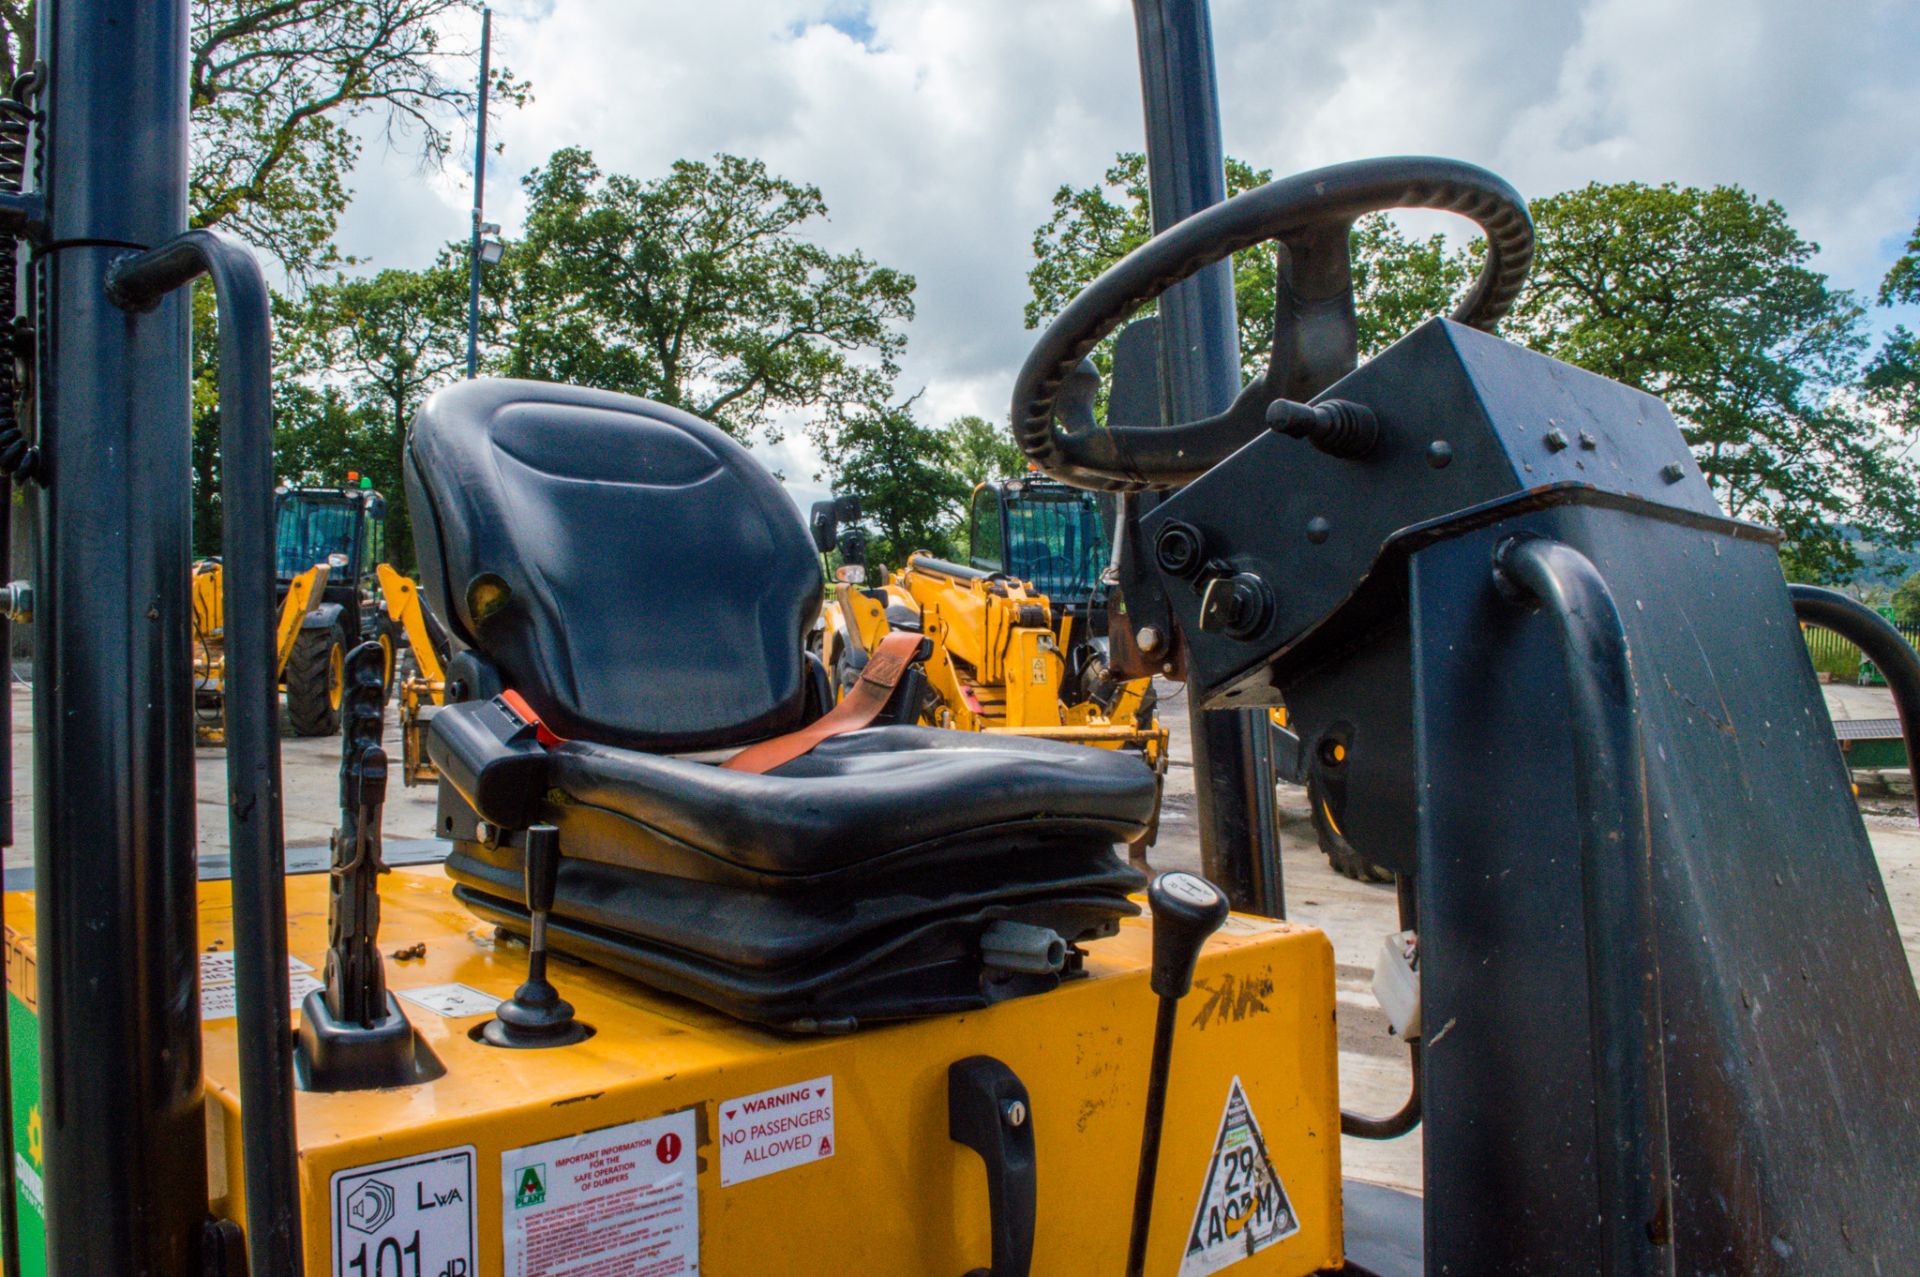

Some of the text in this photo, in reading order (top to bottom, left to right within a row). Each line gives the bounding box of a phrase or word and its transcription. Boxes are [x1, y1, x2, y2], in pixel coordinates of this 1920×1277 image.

[742, 1088, 810, 1115] WARNING
[722, 1107, 831, 1147] NO PASSENGERS
[555, 1138, 652, 1168] IMPORTANT INFORMATION
[589, 1155, 620, 1169] FOR THE
[744, 1134, 812, 1164] ALLOWED
[574, 1162, 635, 1183] SAFE OPERATION
[581, 1173, 629, 1192] OF DUMPERS
[1224, 1145, 1254, 1196] 29
[349, 1230, 421, 1277] 101
